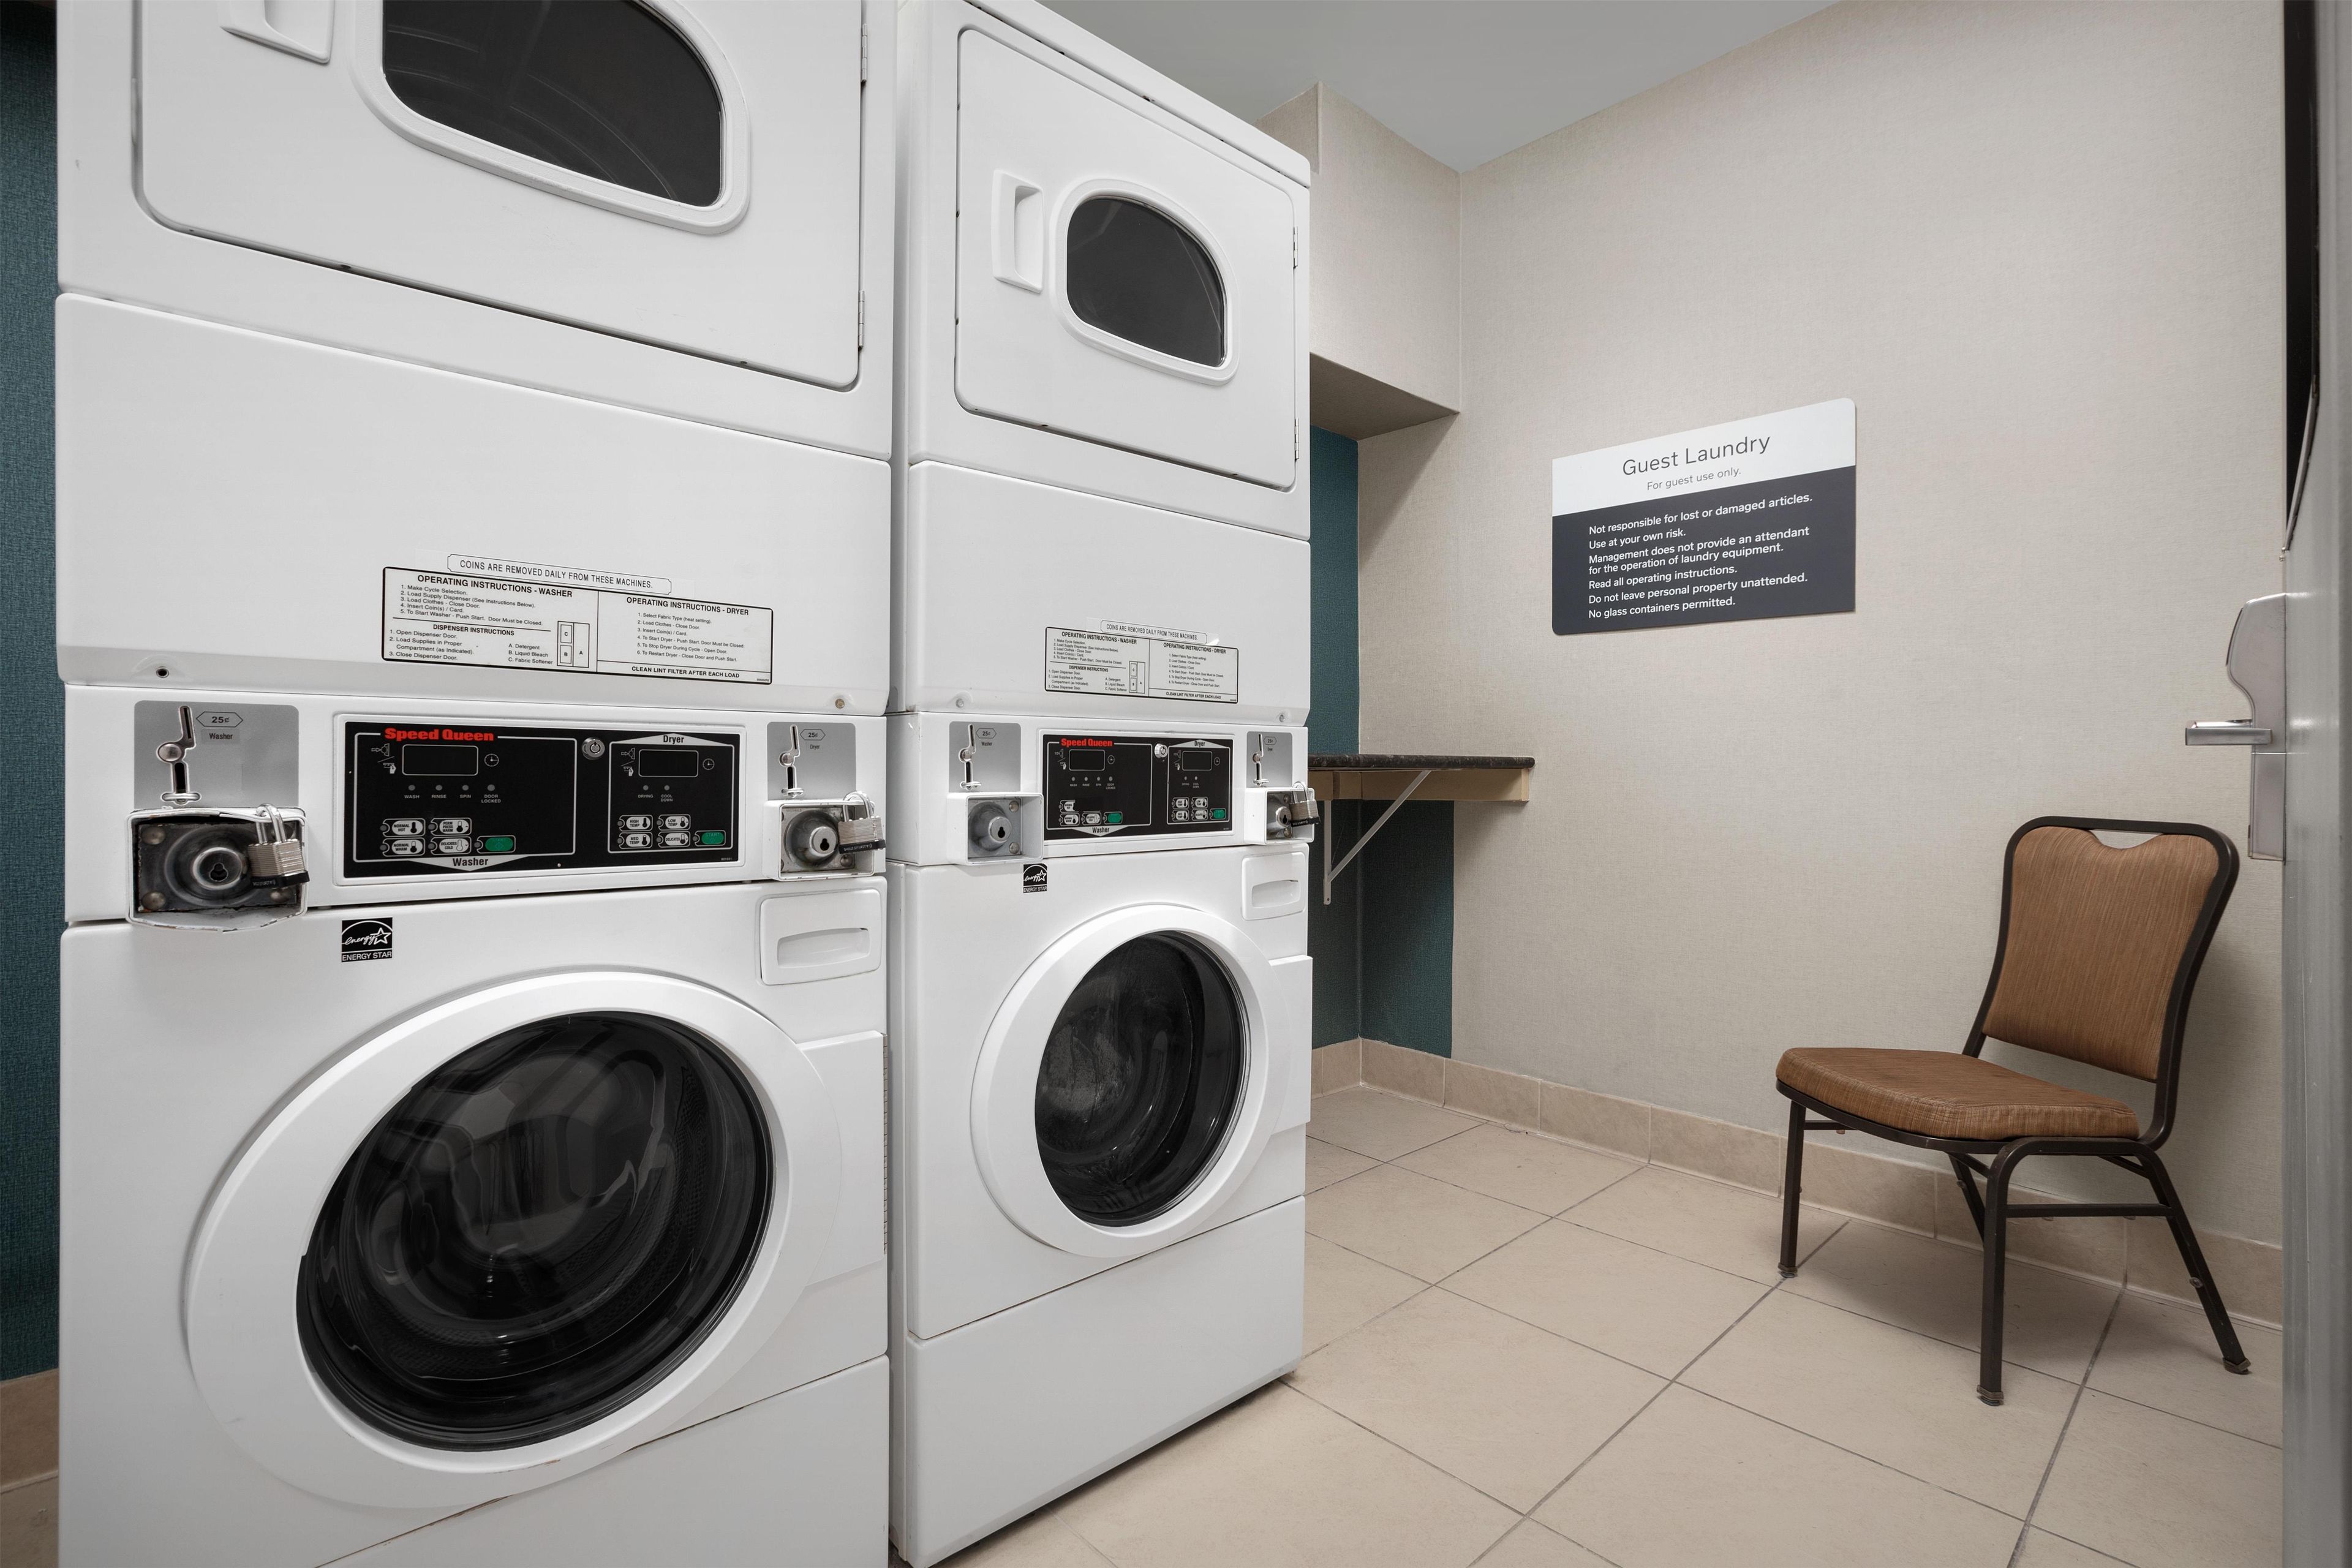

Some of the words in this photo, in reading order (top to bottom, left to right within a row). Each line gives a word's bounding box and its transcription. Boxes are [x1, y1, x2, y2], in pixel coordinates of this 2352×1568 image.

[1623, 451, 1678, 475] Guest
[1686, 436, 1770, 464] Laundry
[1647, 481, 1663, 491] For
[1665, 475, 1693, 489] guest
[1697, 473, 1714, 482] use
[1717, 467, 1741, 478] only.
[1589, 525, 1606, 535] Not
[1608, 516, 1662, 532] responsible
[1664, 514, 1678, 524] for
[1681, 510, 1700, 521] lost
[1702, 509, 1713, 518] or
[1715, 499, 1765, 516] damaged
[1768, 494, 1813, 508] articles.
[1589, 540, 1607, 549] Use
[1608, 538, 1618, 547] at
[1619, 535, 1641, 547] your
[1643, 532, 1664, 541] own
[1666, 527, 1686, 538] risk.
[1589, 548, 1649, 564] Management
[1651, 546, 1675, 556] does
[1678, 542, 1694, 552] not
[1697, 537, 1736, 552] provide
[1738, 536, 1752, 545] an
[1755, 526, 1810, 542] attendant
[1588, 566, 1602, 575] for
[1604, 564, 1618, 573] the
[1621, 558, 1665, 572] operation
[1668, 555, 1679, 565] of
[1681, 551, 1720, 564] laundry
[1722, 543, 1784, 559] equipment.
[460, 560, 485, 570] COINS
[488, 563, 503, 572] ARE
[505, 565, 543, 576] REMOVED
[545, 569, 566, 579] DAILY
[568, 572, 589, 581] FROM
[591, 575, 614, 584] THESE
[616, 578, 652, 589] MACHINES.
[1589, 578, 1611, 589] Read
[1613, 577, 1624, 587] all
[1626, 573, 1672, 586] operating
[1675, 566, 1738, 579] instructions.
[417, 575, 469, 587] OPERATING
[471, 580, 532, 594] INSTRUCTIONS
[538, 587, 573, 598] WASHER
[1589, 595, 1602, 604] Do
[1604, 593, 1619, 603] not
[1621, 592, 1645, 601] leave
[1648, 584, 1690, 600] personal
[1692, 581, 1738, 595] property
[1741, 572, 1808, 589] unattended.
[627, 597, 668, 607] OPERATING
[670, 601, 721, 612] INSTRUCTIONS
[726, 607, 748, 616] DRYER
[1589, 609, 1602, 619] No
[1604, 608, 1627, 619] glass
[1629, 603, 1680, 615] containers
[1683, 596, 1736, 612] permitted.
[470, 627, 514, 636] INSTRUCTIONS
[385, 728, 439, 741] Speed
[442, 729, 494, 741] Queen
[663, 735, 684, 744] Dryer
[1061, 738, 1087, 747] Speed
[453, 858, 489, 867] Washer
